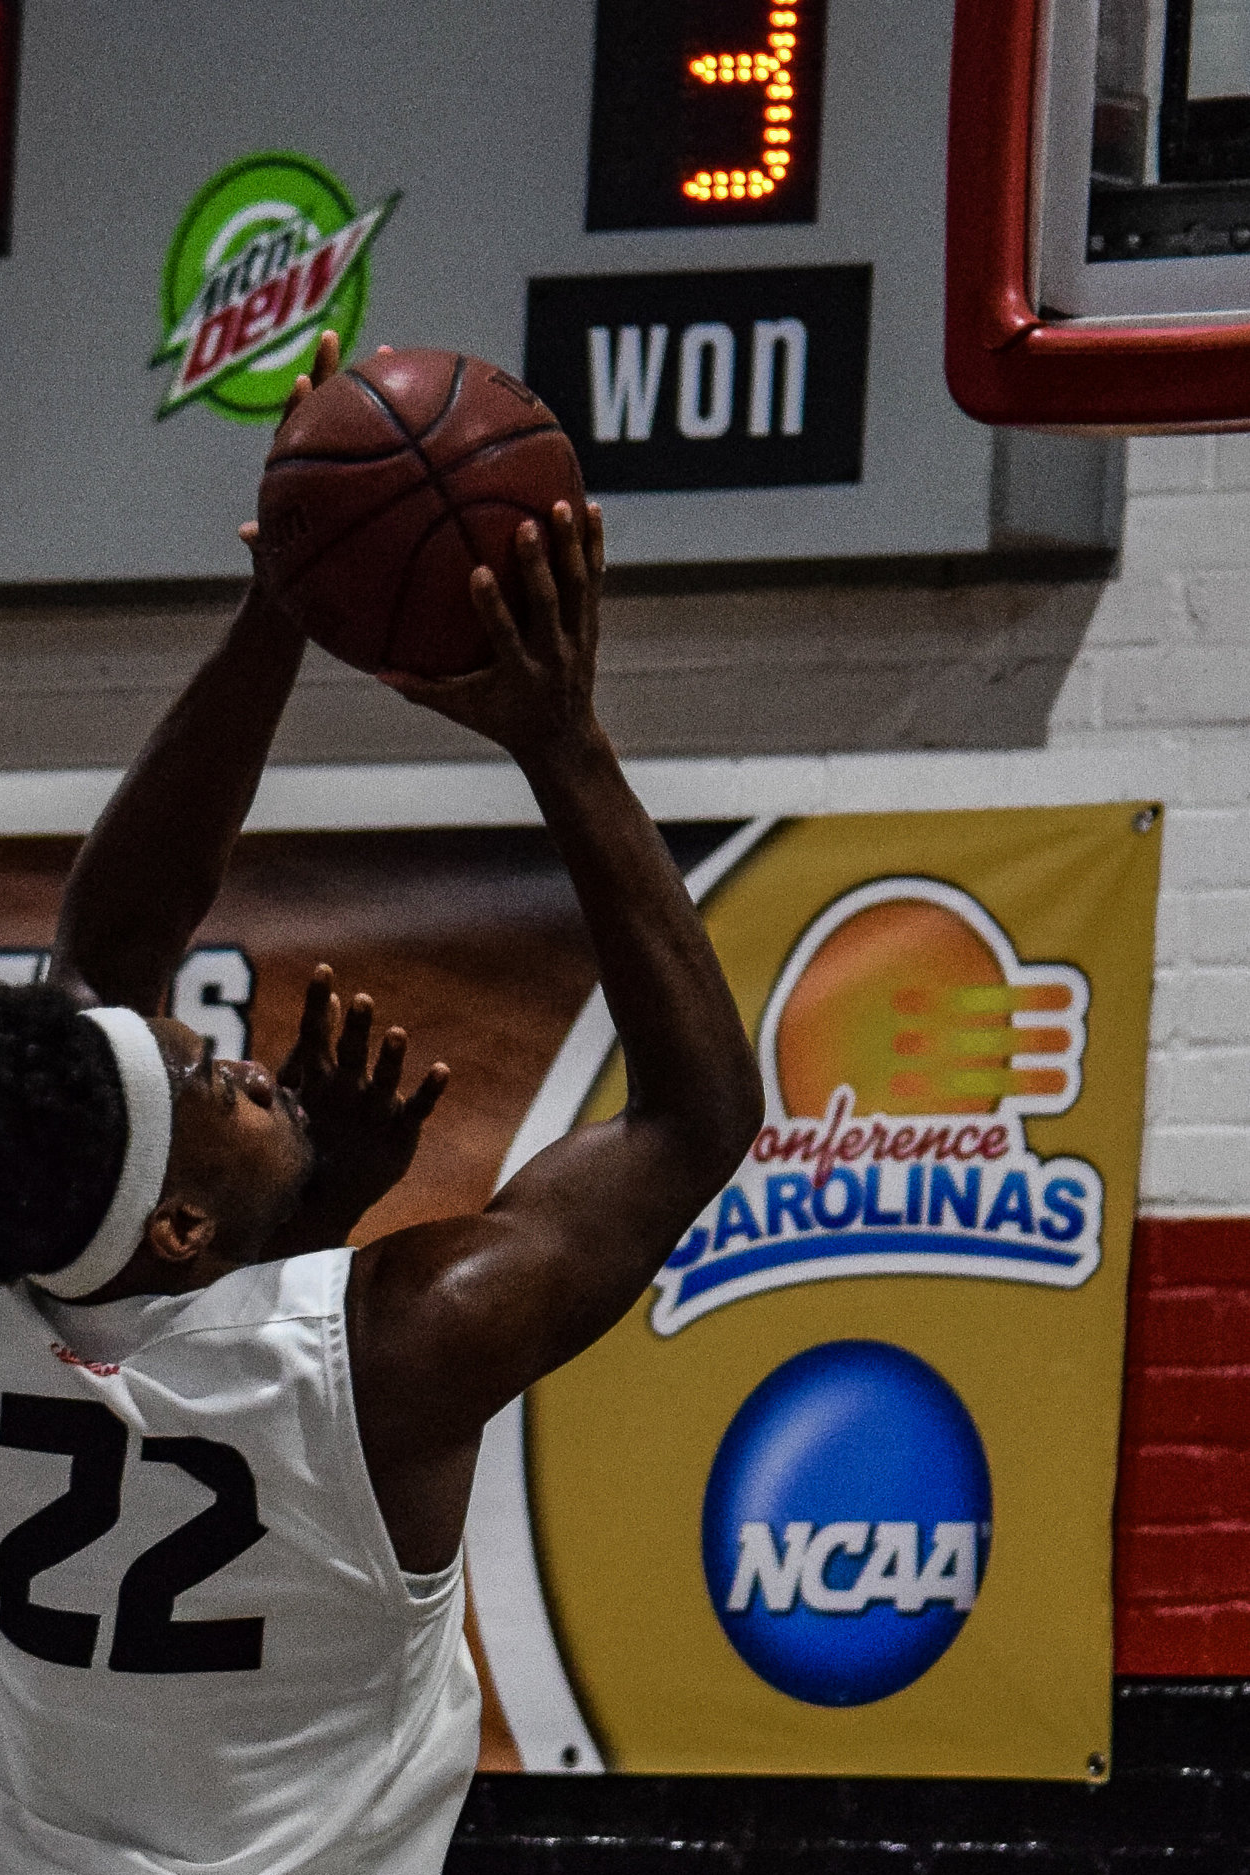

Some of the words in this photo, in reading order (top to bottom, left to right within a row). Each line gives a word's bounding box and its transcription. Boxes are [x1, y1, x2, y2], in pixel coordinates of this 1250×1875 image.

[680, 0, 798, 202] 3
[587, 314, 810, 444] won
[753, 1096, 1010, 1190] onference
[724, 1520, 978, 1614] NCAA
